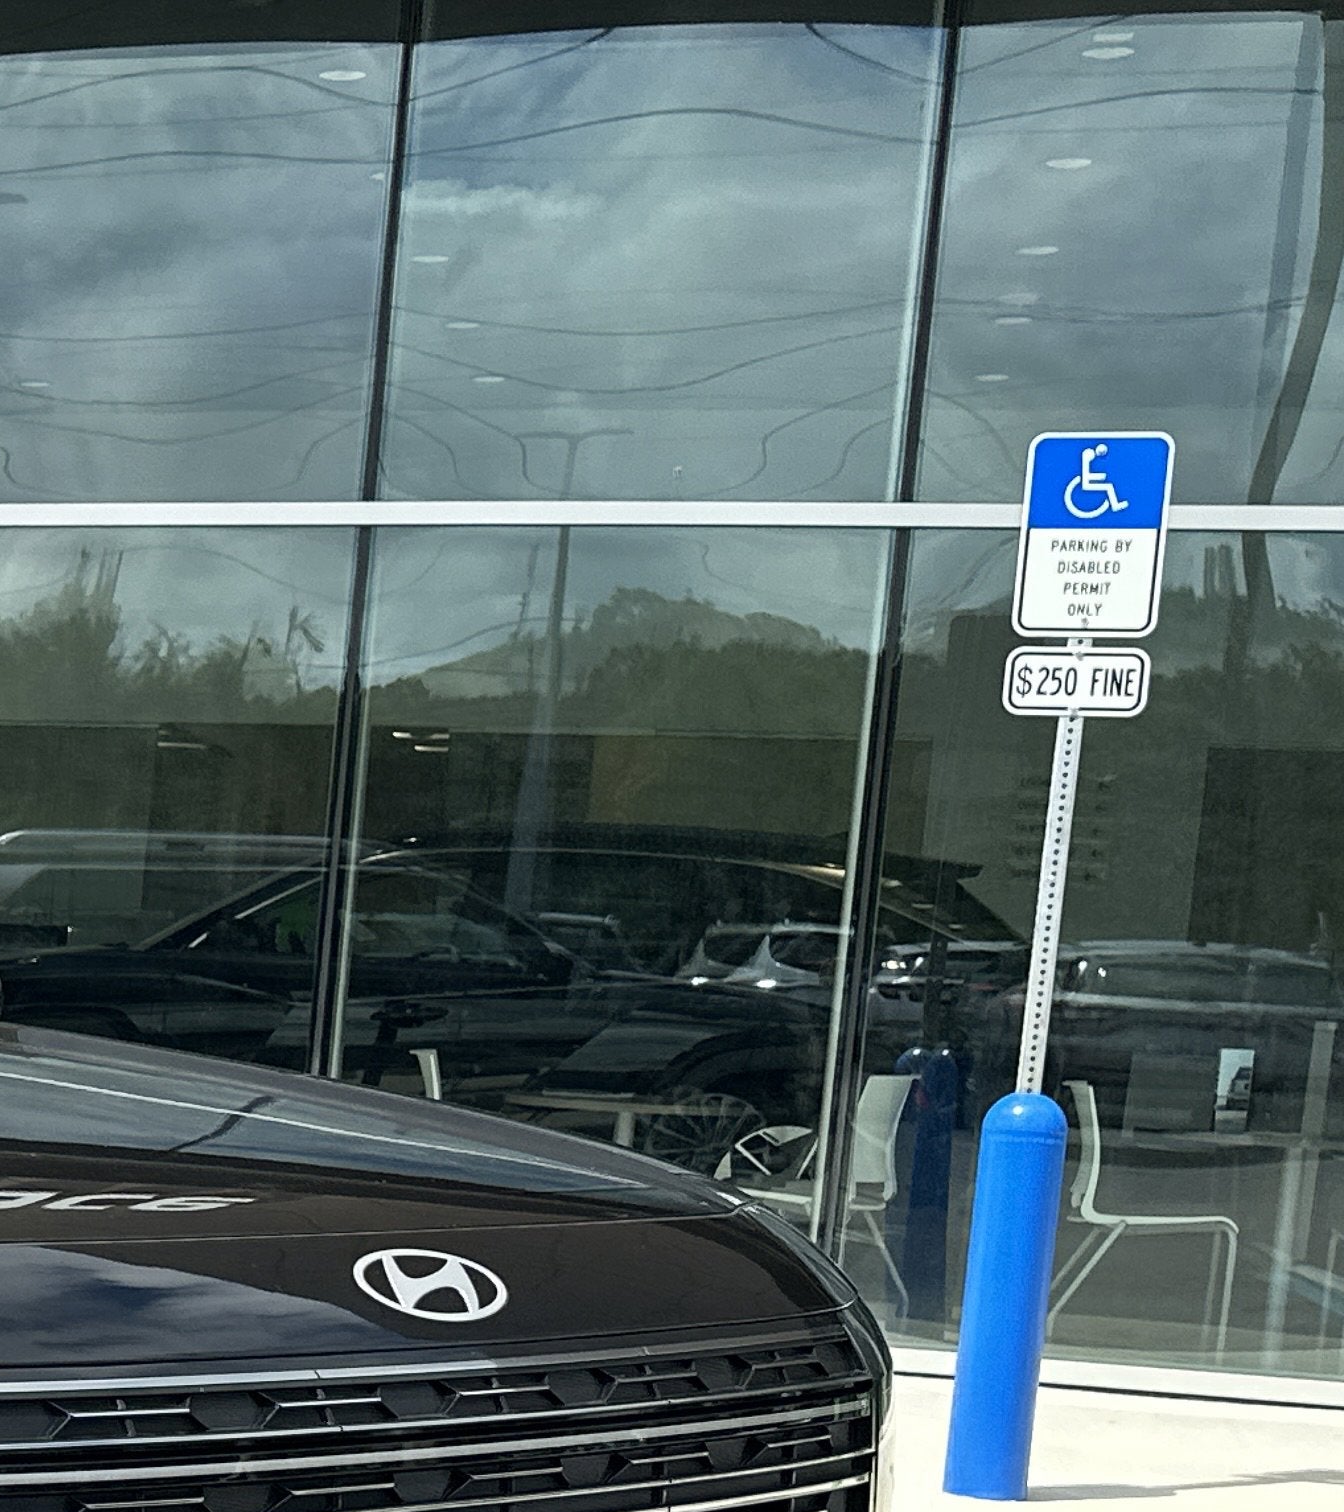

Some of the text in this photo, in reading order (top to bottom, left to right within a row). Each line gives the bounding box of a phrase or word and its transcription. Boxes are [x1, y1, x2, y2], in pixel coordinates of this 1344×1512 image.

[1051, 539, 1133, 553] PARKING BY
[1057, 560, 1121, 575] DISABLED
[1063, 582, 1111, 596] PERMIT
[1067, 603, 1103, 617] ONLY
[1015, 663, 1136, 698] $250 FINE
